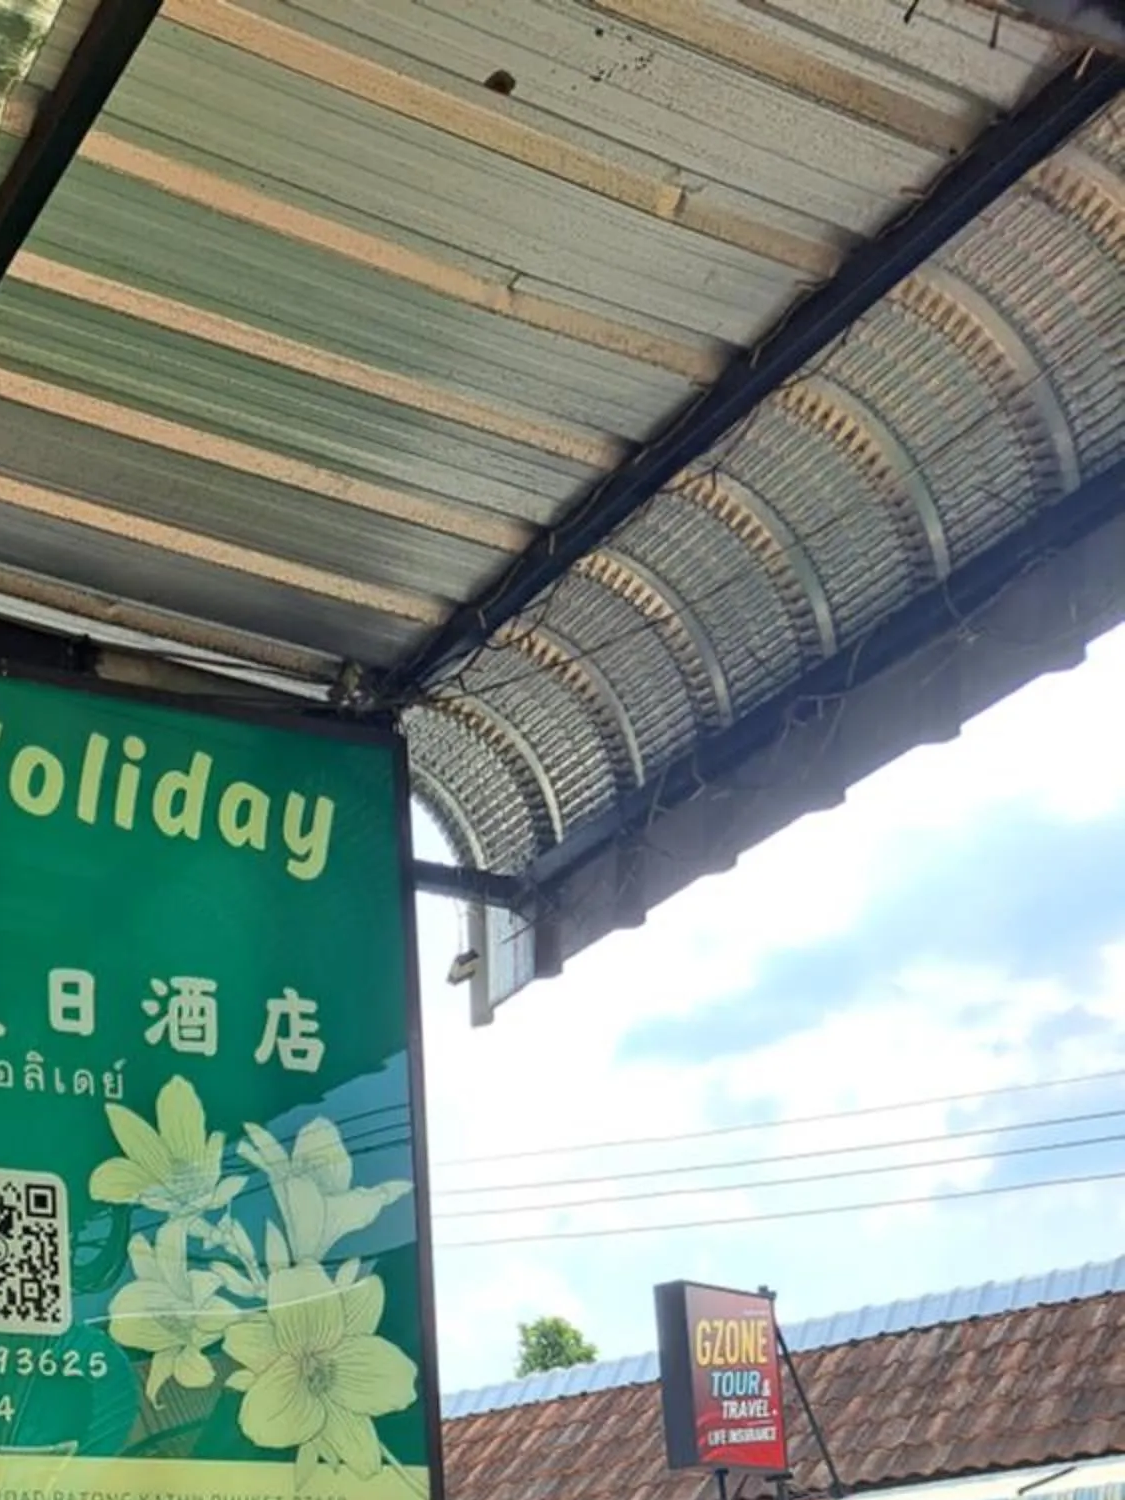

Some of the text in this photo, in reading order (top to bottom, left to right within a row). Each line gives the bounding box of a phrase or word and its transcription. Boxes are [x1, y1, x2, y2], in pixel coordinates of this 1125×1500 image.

[696, 1318, 769, 1367] GZONE
[711, 1370, 761, 1398] TOUR
[722, 1400, 771, 1420] TRAVEL
